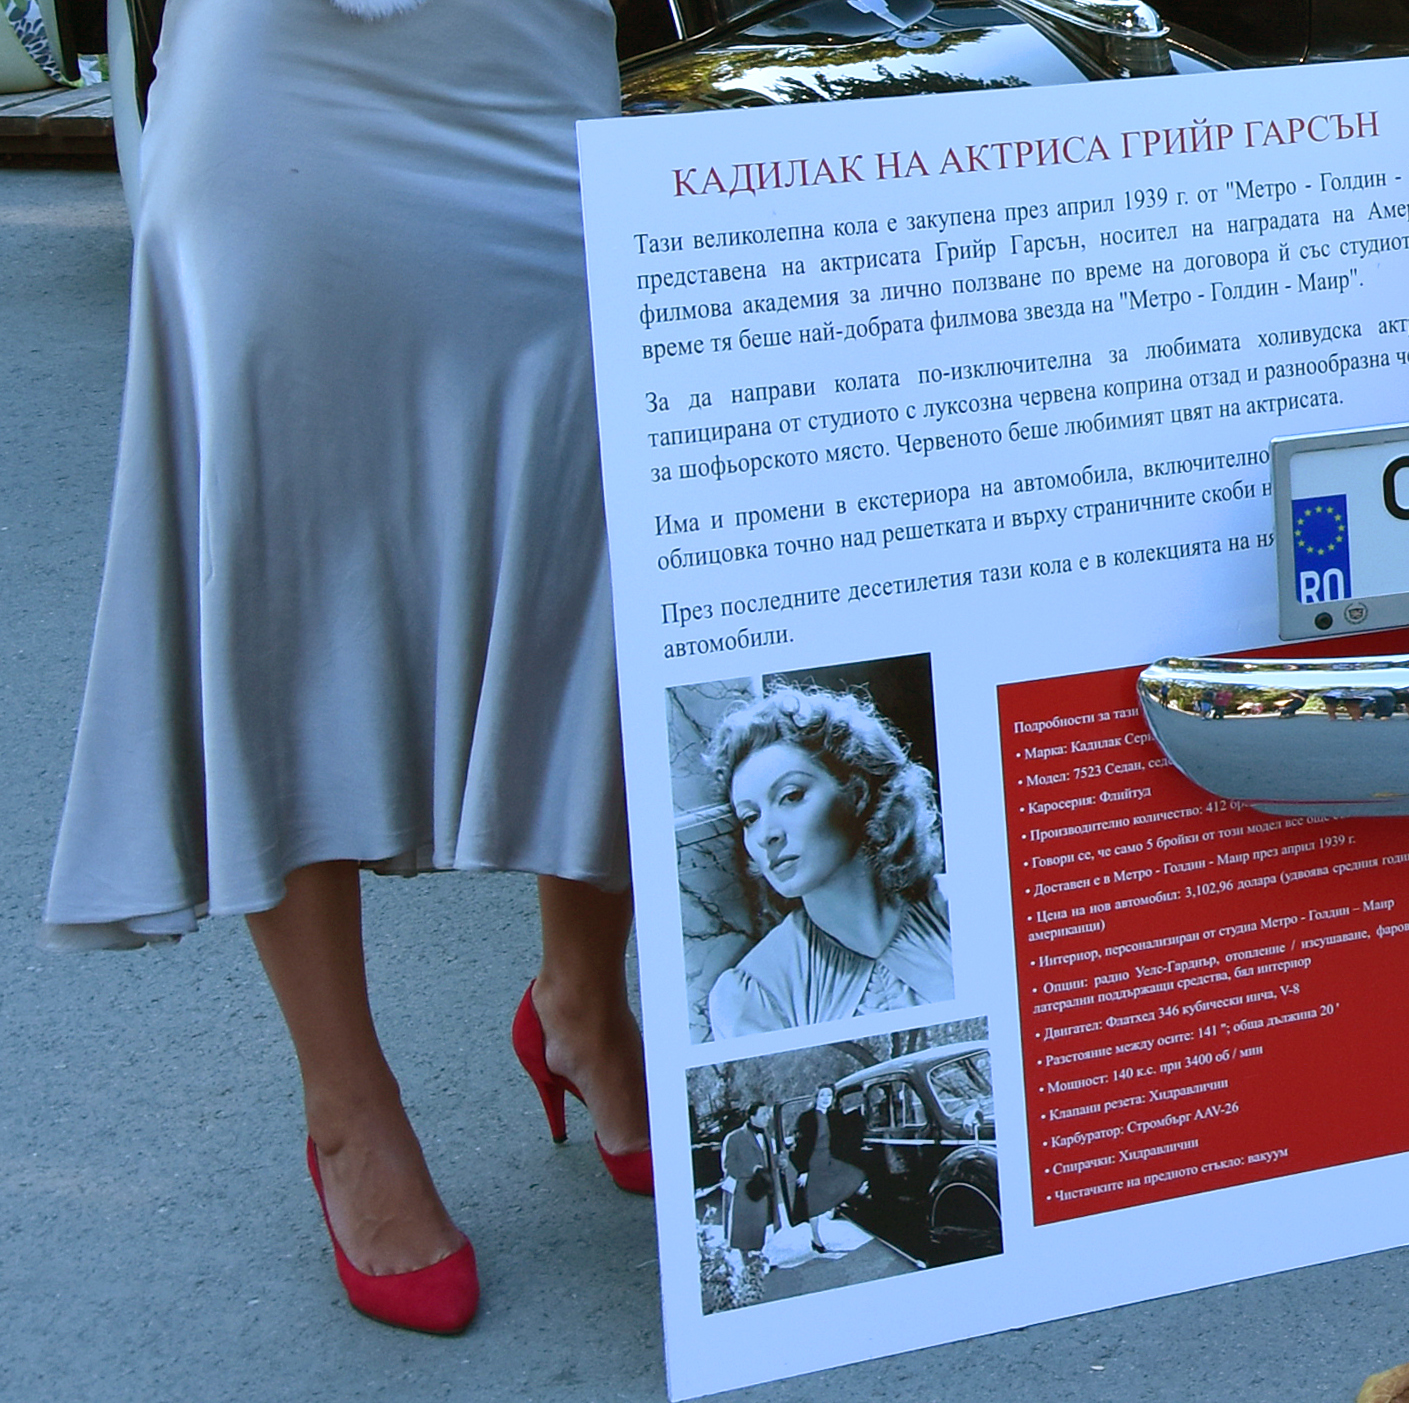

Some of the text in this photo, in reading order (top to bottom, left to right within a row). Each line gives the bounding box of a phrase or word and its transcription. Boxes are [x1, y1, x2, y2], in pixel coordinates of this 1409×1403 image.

[671, 110, 1380, 199] КАДИЛАК НА АКТРИСА ГРИЙР ГАРСЪН
[633, 233, 684, 255] Тази
[692, 224, 825, 250] великолепна
[833, 219, 879, 237] кола
[886, 217, 898, 233] е
[906, 208, 997, 234] закупена
[1004, 203, 1049, 227] през
[1056, 197, 1115, 221] април
[1125, 187, 1168, 211] 1939
[1176, 191, 1189, 206] г.
[1197, 188, 1219, 204] от
[1225, 179, 1297, 203] "Метро
[1319, 171, 1387, 192] Голдин
[636, 263, 768, 295] представена
[781, 260, 806, 277] на
[820, 249, 922, 276] актрисата
[934, 238, 997, 267] Грийр
[1009, 233, 1086, 259] Гарсън,
[1099, 225, 1178, 247] носител
[1191, 221, 1215, 238] на
[1226, 211, 1320, 237] наградата
[1332, 208, 1355, 224] на
[639, 301, 733, 331] филмова
[742, 291, 840, 315] академия
[849, 288, 871, 305] за
[879, 281, 942, 302] лично
[951, 271, 1042, 295] ползване
[1051, 268, 1075, 285] по
[1084, 262, 1143, 286] време
[1151, 258, 1175, 275] на
[1183, 249, 1270, 274] договора
[1278, 242, 1291, 262] й
[1299, 243, 1331, 260] със
[645, 391, 671, 413] За
[688, 391, 713, 412] да
[731, 381, 817, 406] направи
[834, 372, 901, 393] колата
[917, 352, 1093, 385] по-изключителна
[1108, 348, 1129, 364] за
[1145, 336, 1242, 360] любимата
[1257, 323, 1363, 348] холивудска
[647, 420, 773, 448] тапицирана
[778, 417, 802, 434] от
[807, 406, 900, 434] студиото
[905, 404, 917, 420] с
[922, 394, 1014, 423] луксозна
[1018, 385, 1097, 411] червена
[1103, 375, 1183, 400] коприна
[1189, 369, 1242, 389] отзад
[1246, 367, 1259, 382] и
[1264, 352, 1391, 386] разнообразна
[650, 390, 1344, 483] за шофьорското място. Червеното беше любимият цвят на актрисата.
[1300, 567, 1346, 605] RO
[663, 627, 794, 659] автомобили.
[1013, 707, 1140, 735] Подробности за тази
[1023, 737, 1123, 761] Марка: Кадилак
[1027, 786, 1153, 816] Каросерия: Флийтуд
[1028, 817, 1131, 844] Производително
[1131, 805, 1204, 826] количество:
[1204, 800, 1229, 815] 412
[1035, 909, 1069, 924] Цена
[1070, 906, 1087, 918] на
[1088, 902, 1112, 915] нов
[1113, 889, 1182, 911] автомобил:
[1184, 878, 1235, 900] 3,102,96
[1236, 874, 1278, 891] долара
[1279, 866, 1330, 885] (удвоява
[1331, 857, 1379, 876] средния
[1027, 918, 1106, 943] американци)
[1032, 956, 1312, 1015] латерални поддържащи средства, бял интериор
[1042, 982, 1301, 1043] Двигател: Флатхед 346 кубически инча, V-8
[1046, 1045, 1264, 1095] Мощност: 140 к.с. при 3400 об мин
[1048, 1078, 1229, 1122] Клапани резета: Хидравлични
[1050, 1100, 1240, 1149] Карбуратор: Стромбърг AAV-26
[1051, 1138, 1200, 1176] Спирачки: Хидравлични
[1053, 1147, 1289, 1202] Чистачките на предното стъкло: вакуум
